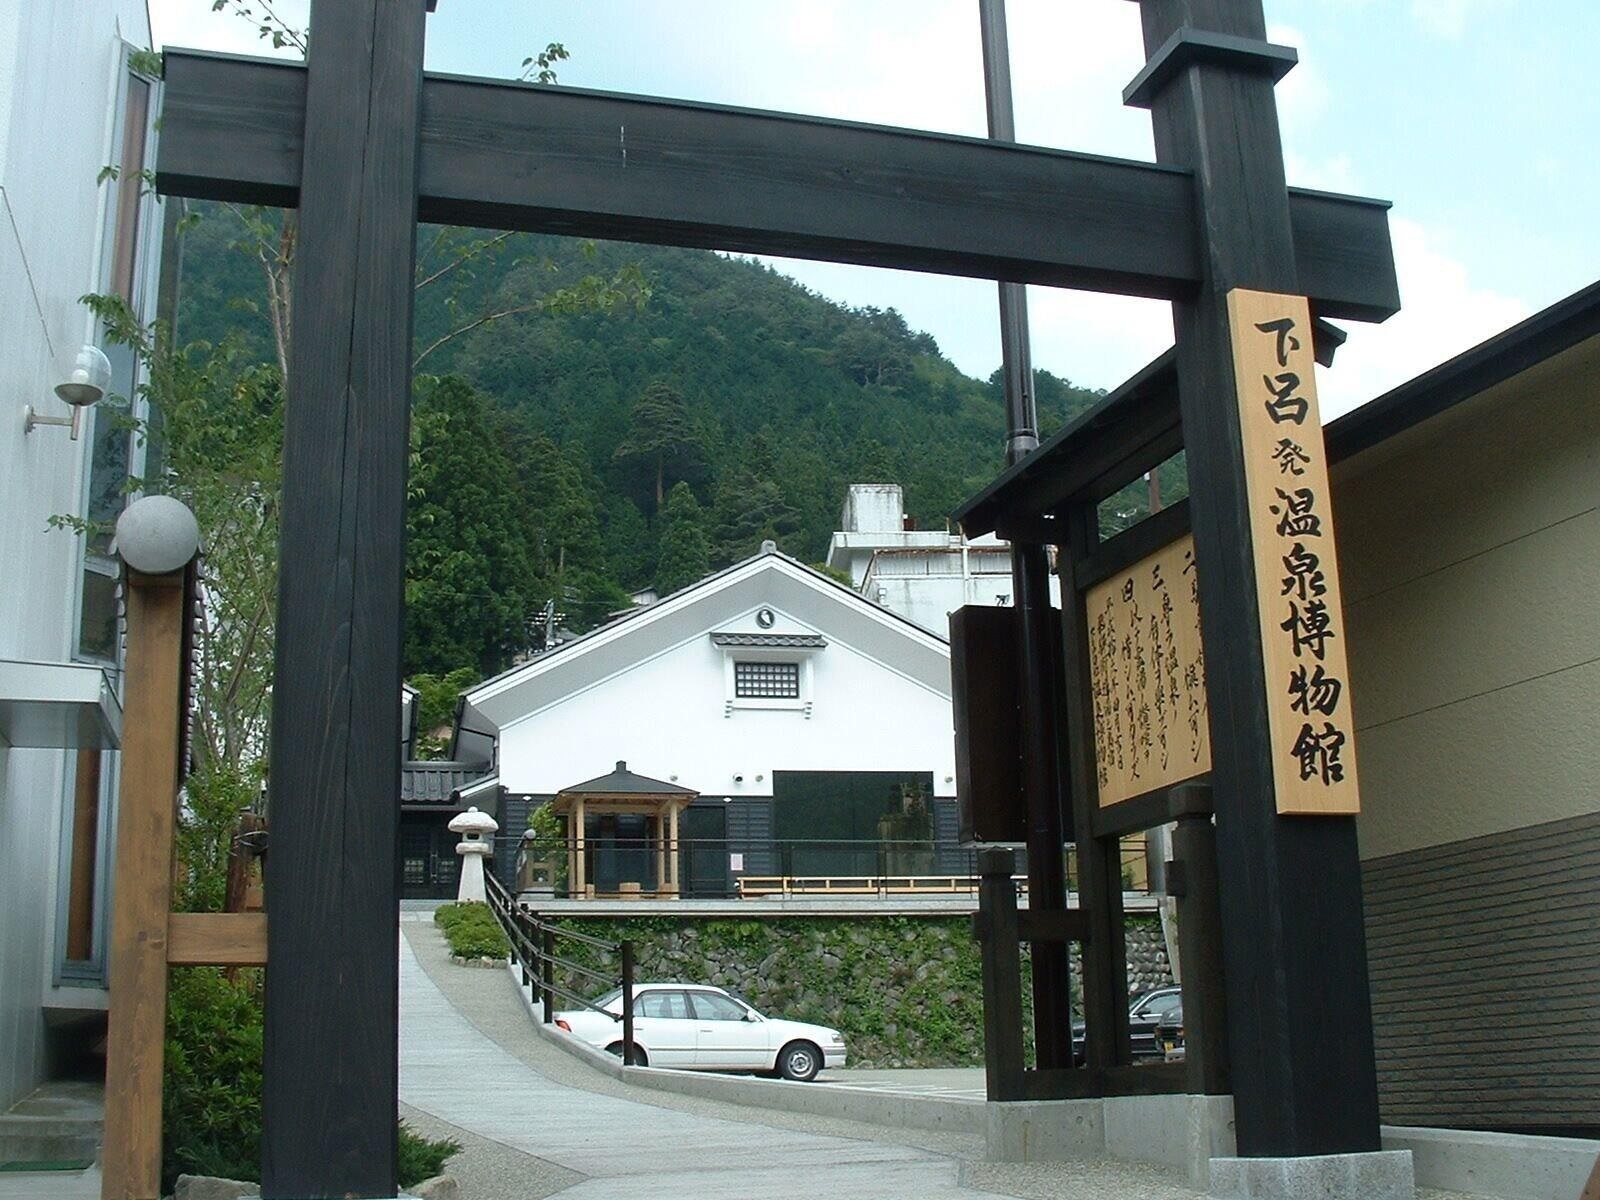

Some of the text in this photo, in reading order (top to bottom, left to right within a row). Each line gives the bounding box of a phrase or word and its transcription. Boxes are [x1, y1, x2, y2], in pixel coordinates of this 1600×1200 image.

[1254, 318, 1344, 786] 下呂発温泉博物館
